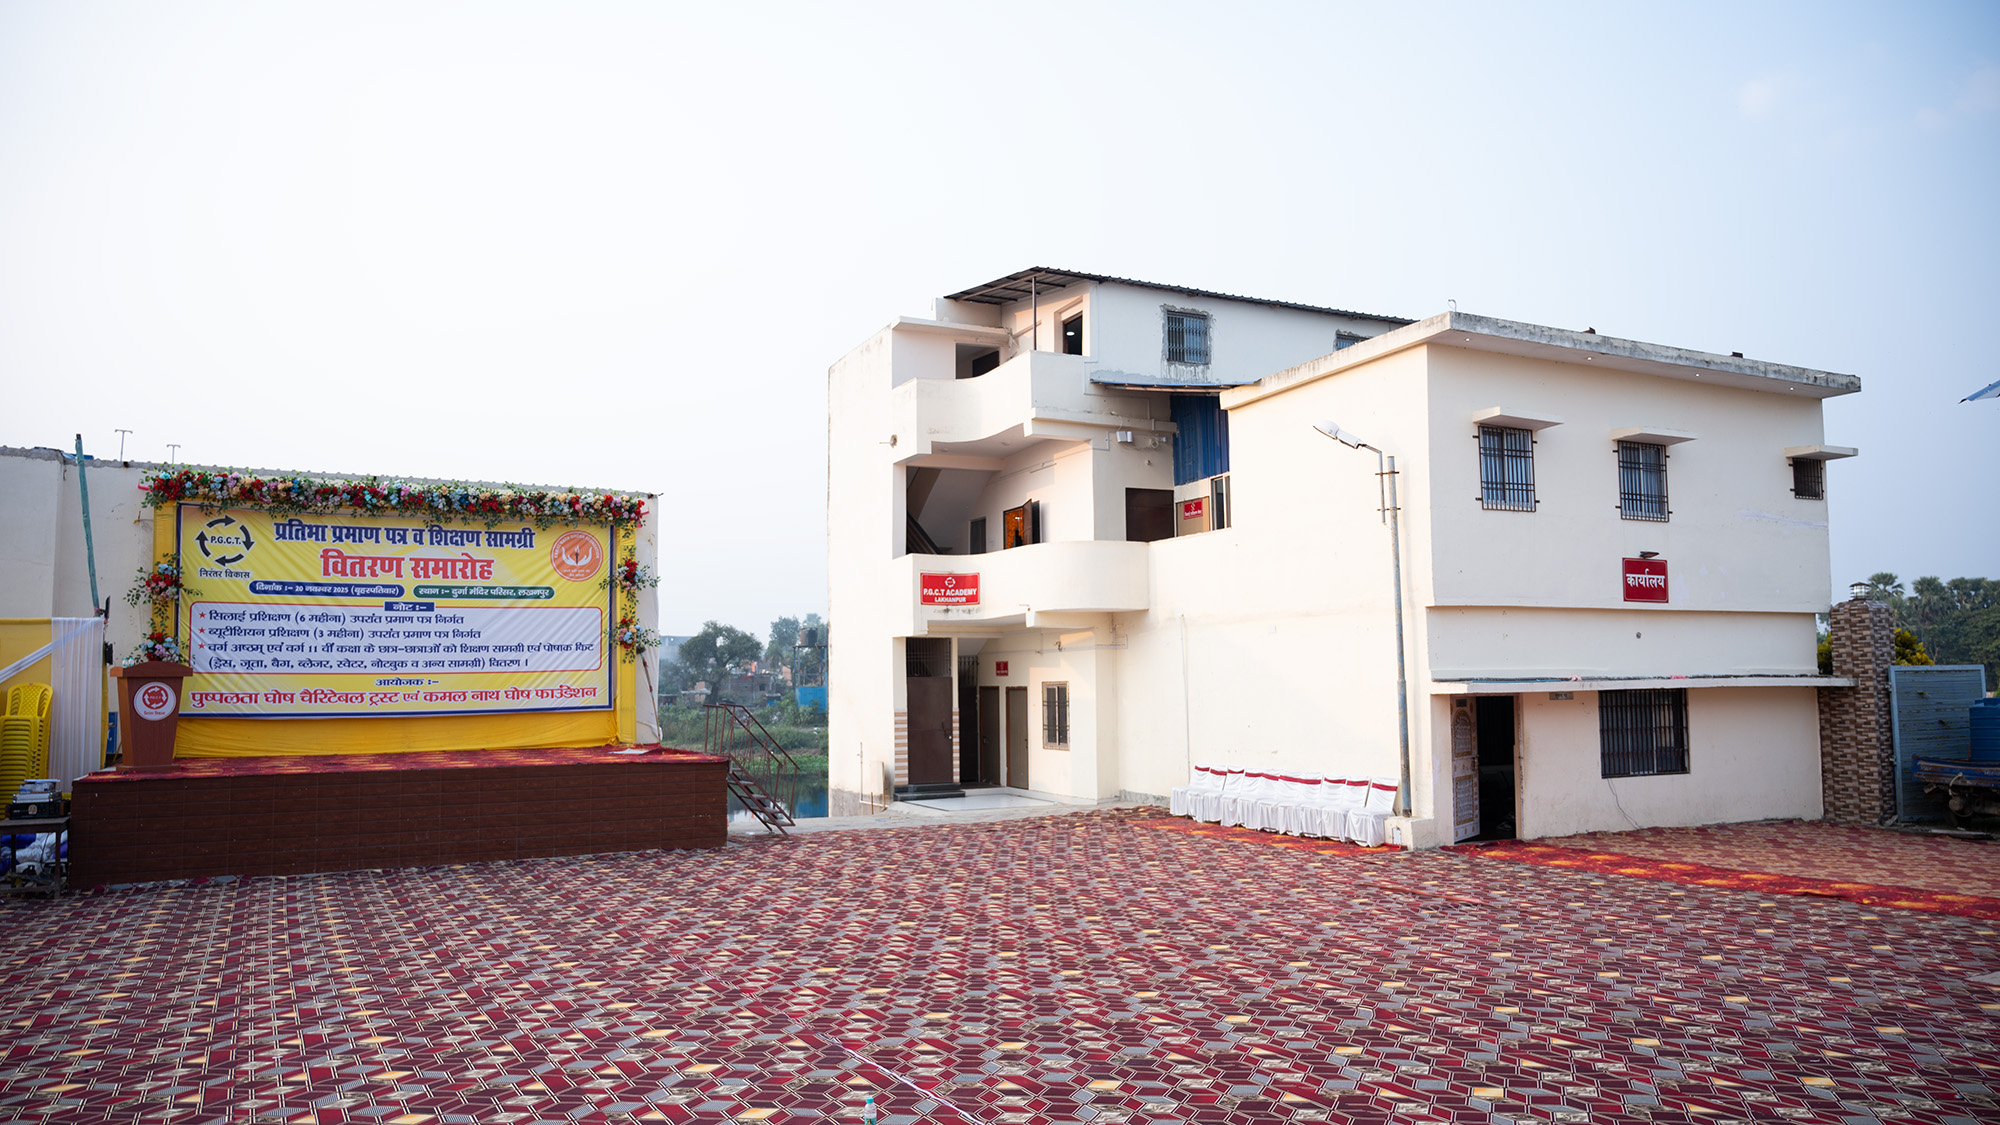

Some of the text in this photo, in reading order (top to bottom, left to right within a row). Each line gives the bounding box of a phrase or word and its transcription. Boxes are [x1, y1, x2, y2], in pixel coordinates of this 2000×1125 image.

[210, 535, 241, 545] P.G.C.T.
[274, 518, 536, 549] प्रतिभा प्रमाण पत्र व शिक्षण सामग्री
[320, 548, 494, 580] वितरण समारोह
[199, 567, 250, 579] निरंतर विकास
[1626, 568, 1665, 588] कार्यालय
[256, 582, 283, 591] दिनांक
[333, 586, 348, 594] 2025
[419, 587, 439, 595] स्थान
[451, 586, 468, 598] दुर्गा
[469, 586, 489, 596] मंदिर
[518, 589, 550, 599] लखनपुर
[946, 588, 977, 596] ACADEMY
[393, 602, 413, 611] नोट
[209, 610, 464, 626] सिलाई प्रशिक्षण (6 महीना) उपरांत प्रमाण पत्र निर्गत
[208, 625, 481, 641] ब्यूटीशियन प्रशिक्षण (3 महीना) उपरांत प्रमाण पत्र निर्गत
[208, 641, 228, 652] वर्ग
[267, 642, 284, 653] एवं
[286, 642, 305, 653] वर्ग
[321, 642, 335, 653] वीं
[336, 645, 361, 653] कक्षा
[364, 643, 376, 653] के
[443, 644, 457, 653] को
[460, 643, 490, 653] शिक्षण
[492, 643, 525, 654] सामग्री
[527, 642, 542, 653] एवं
[543, 642, 572, 652] पोषाक
[575, 642, 594, 652] किट
[240, 660, 267, 671] जूता,
[371, 658, 408, 671] नोटबुक
[422, 660, 445, 668] अन्य
[448, 657, 486, 670] सामग्री)
[489, 657, 520, 667] वितरण
[375, 677, 425, 686] आयोजक
[190, 684, 598, 709] पुष्पलता घोष चैरिटेबल ट्रस्ट एवं कमल नाथ घोष फाउंडेशन
